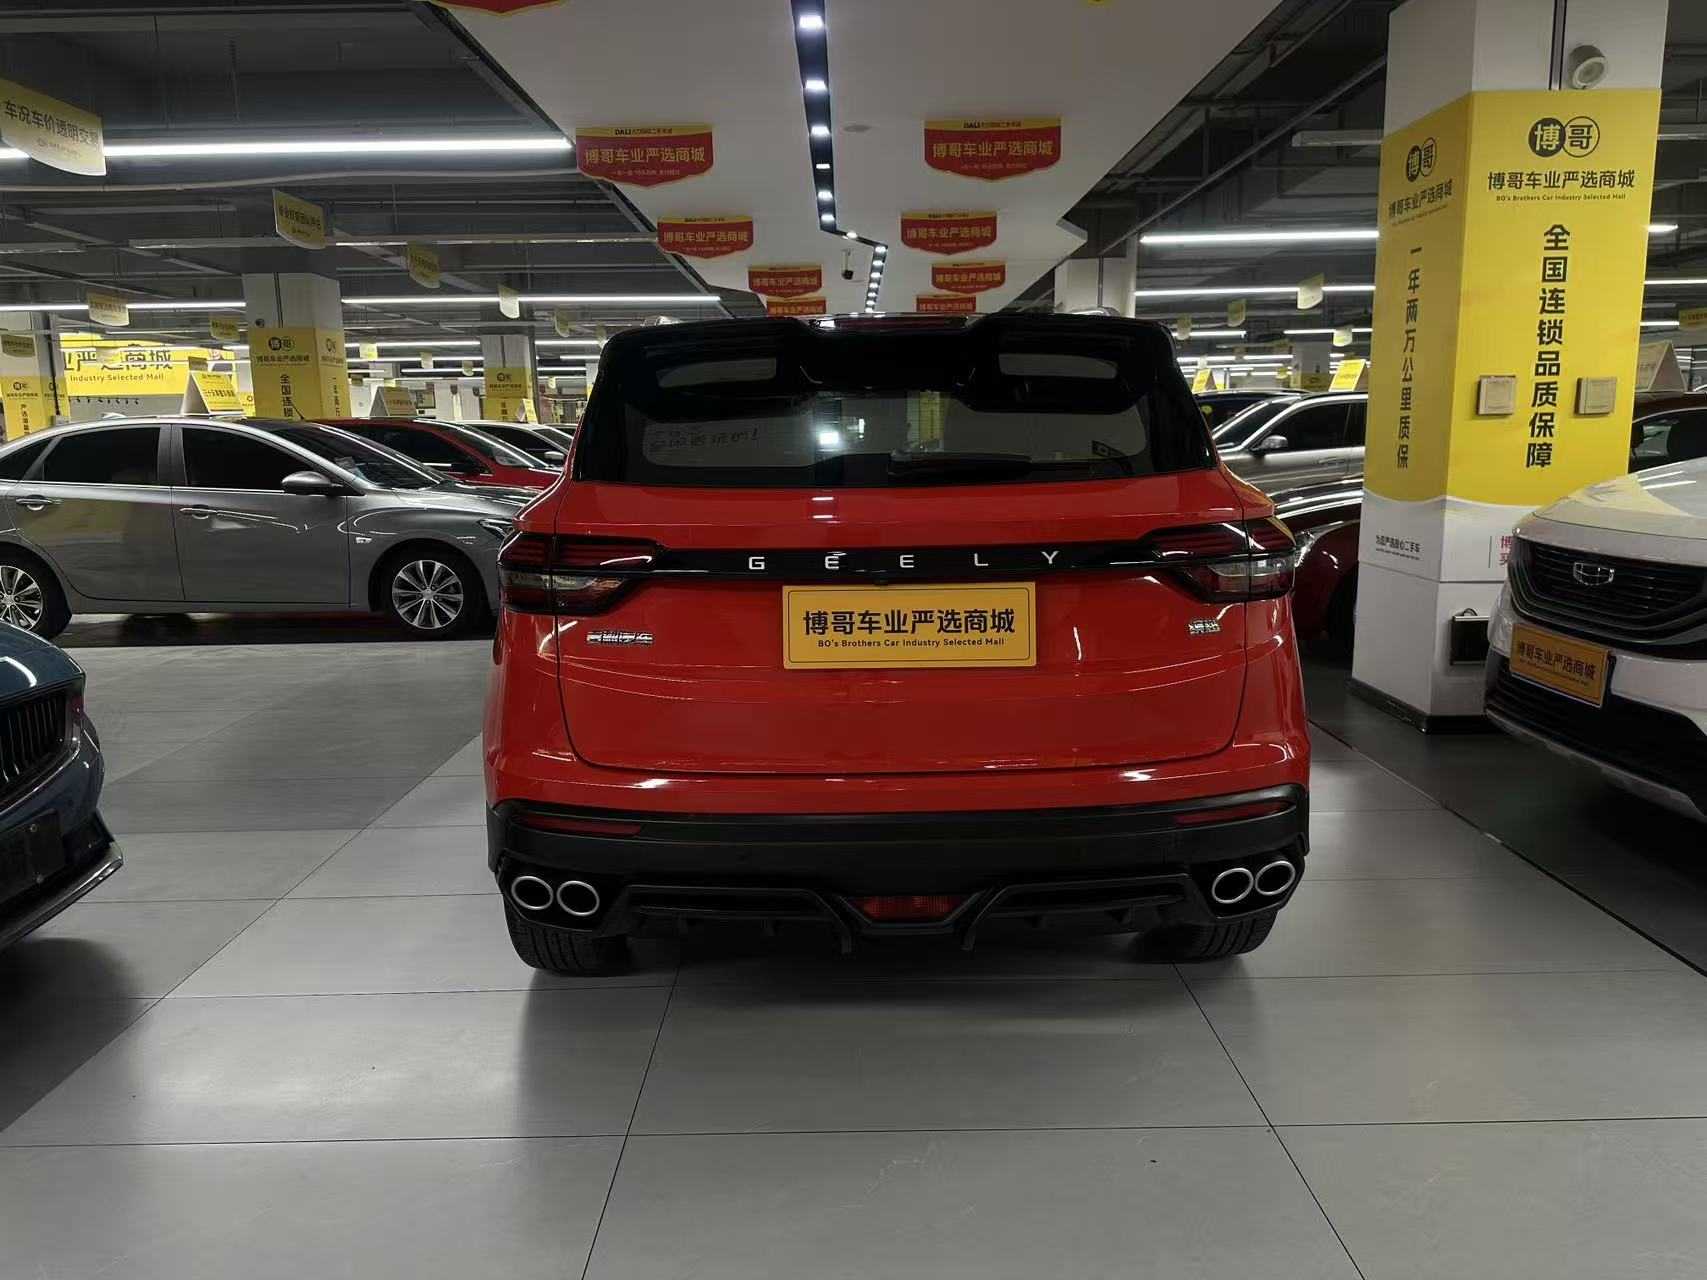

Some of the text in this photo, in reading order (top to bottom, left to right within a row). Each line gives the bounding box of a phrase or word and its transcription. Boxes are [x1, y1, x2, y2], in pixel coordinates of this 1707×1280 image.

[1532, 121, 1596, 153] 博哥
[585, 146, 705, 164] 博哥车业严选商城
[933, 140, 1054, 159] 博哥车业严选商城
[1407, 140, 1436, 180] 博哥
[1488, 169, 1635, 190] 博哥车业严选商城
[1555, 194, 1581, 202] Industry
[1526, 224, 1570, 468] 全国连锁品质保障
[1397, 247, 1423, 468] 一年两万公里质保
[70, 372, 164, 383] Industry Selected Mall
[748, 551, 1059, 570] GEELY
[803, 608, 1015, 636] 博哥车业严选商城
[818, 637, 1005, 649] BO's Brothers Car Industry Selected Mall
